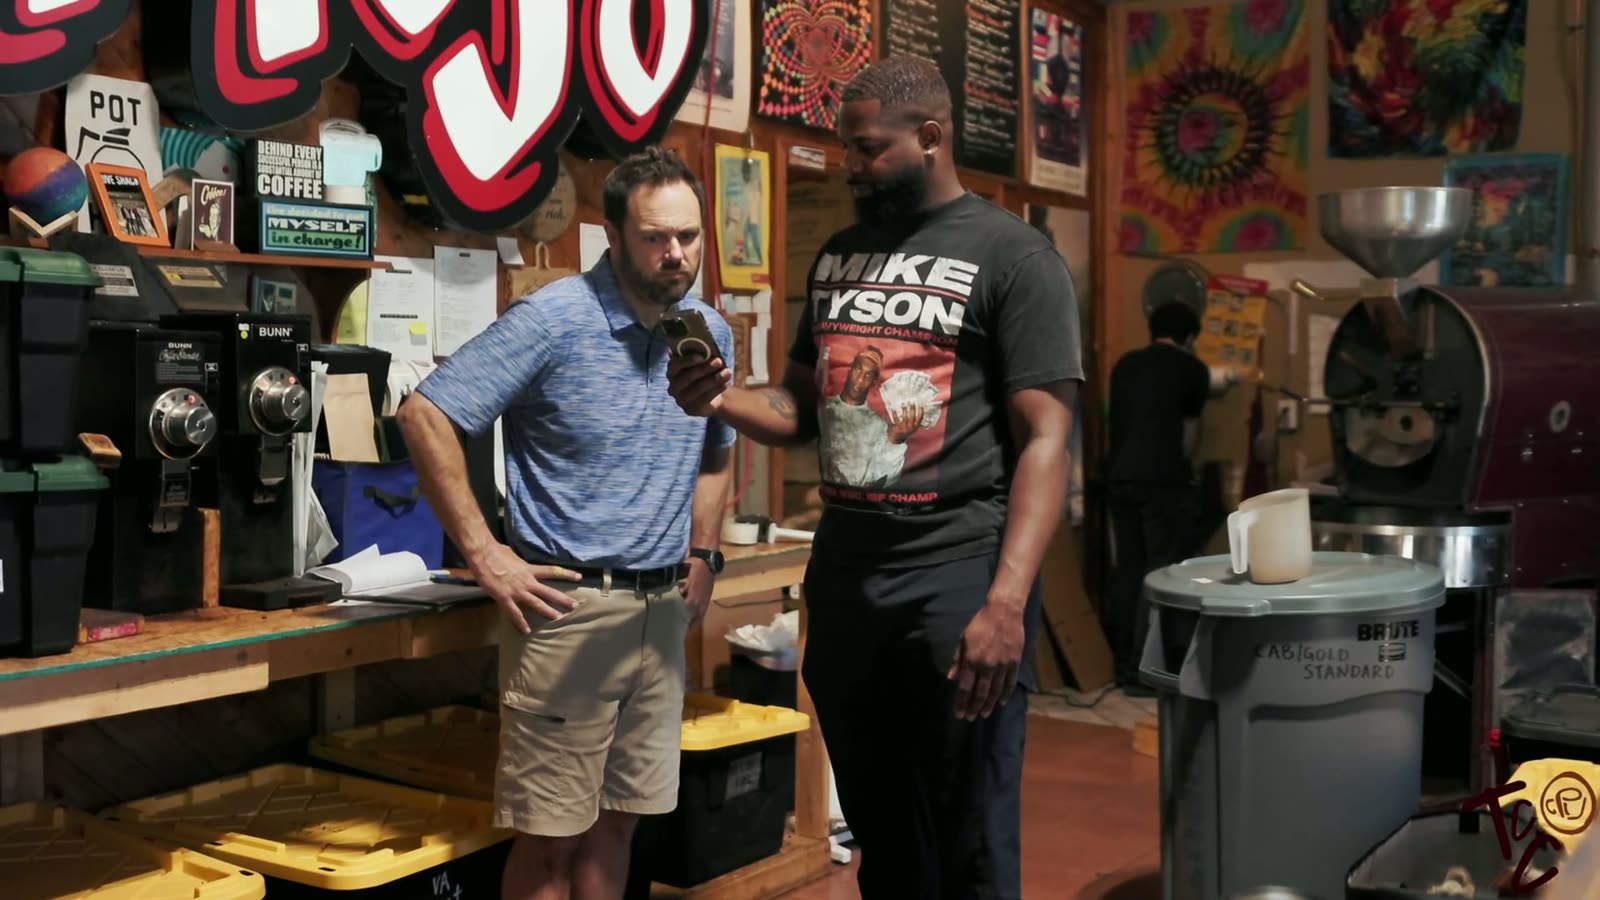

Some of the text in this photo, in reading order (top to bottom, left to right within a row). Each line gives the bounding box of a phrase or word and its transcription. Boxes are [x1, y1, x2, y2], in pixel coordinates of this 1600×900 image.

[90, 90, 141, 126] POT
[258, 140, 322, 161] BEHIND EVERY
[258, 174, 322, 199] COFFEE
[268, 217, 364, 233] MYSELF
[272, 231, 361, 249] in charge!
[814, 252, 980, 296] MIKE
[812, 289, 965, 335] TYSON
[259, 327, 290, 337] BUNN
[888, 491, 938, 502] CHAMP
[1357, 620, 1419, 642] BRUTE
[1303, 662, 1395, 681] STANDARD
